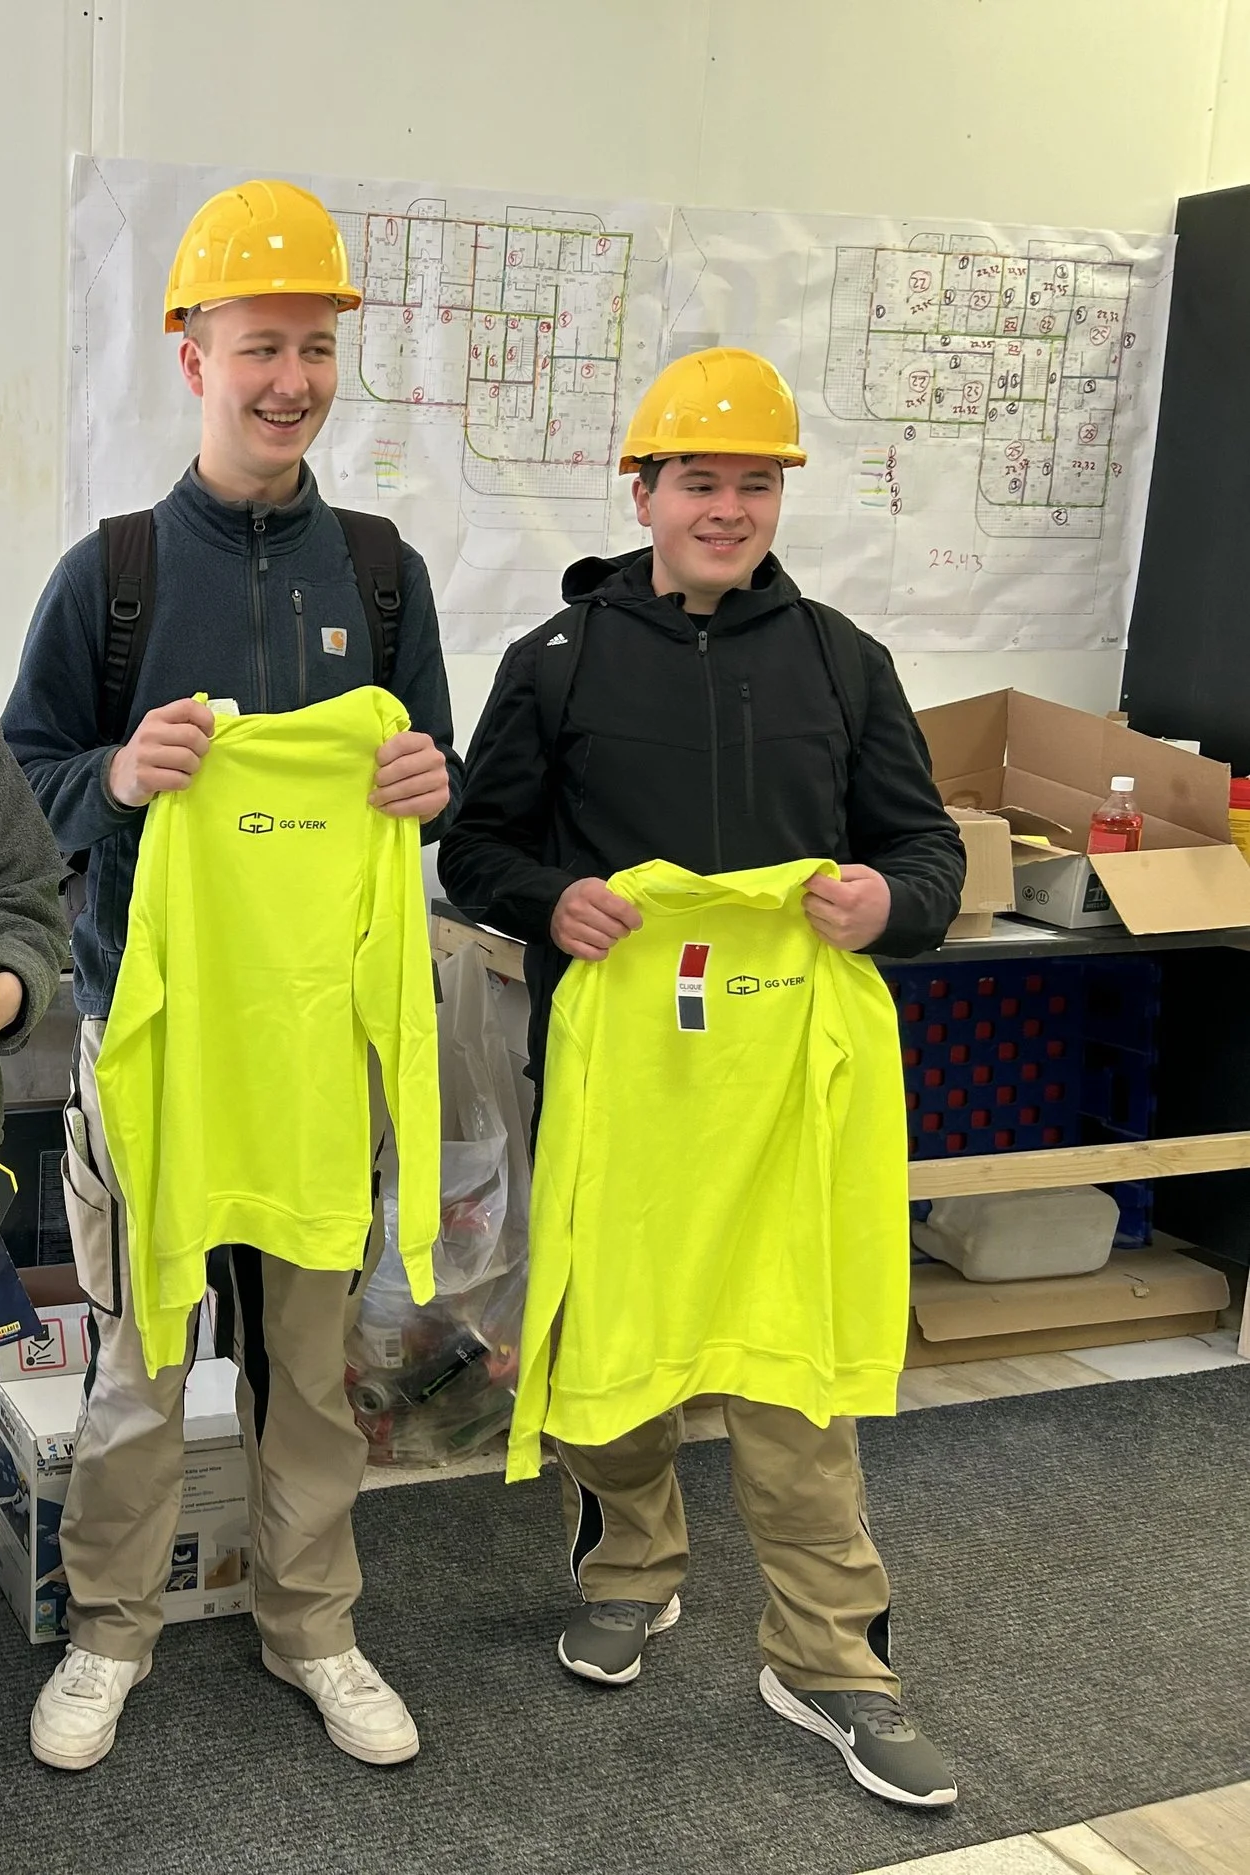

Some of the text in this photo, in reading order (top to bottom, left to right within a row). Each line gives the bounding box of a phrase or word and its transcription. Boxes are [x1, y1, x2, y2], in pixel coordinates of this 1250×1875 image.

[910, 276, 927, 290] 22
[929, 548, 983, 572] 22,43
[279, 820, 327, 829] GG VERK
[764, 975, 806, 988] GG VERK
